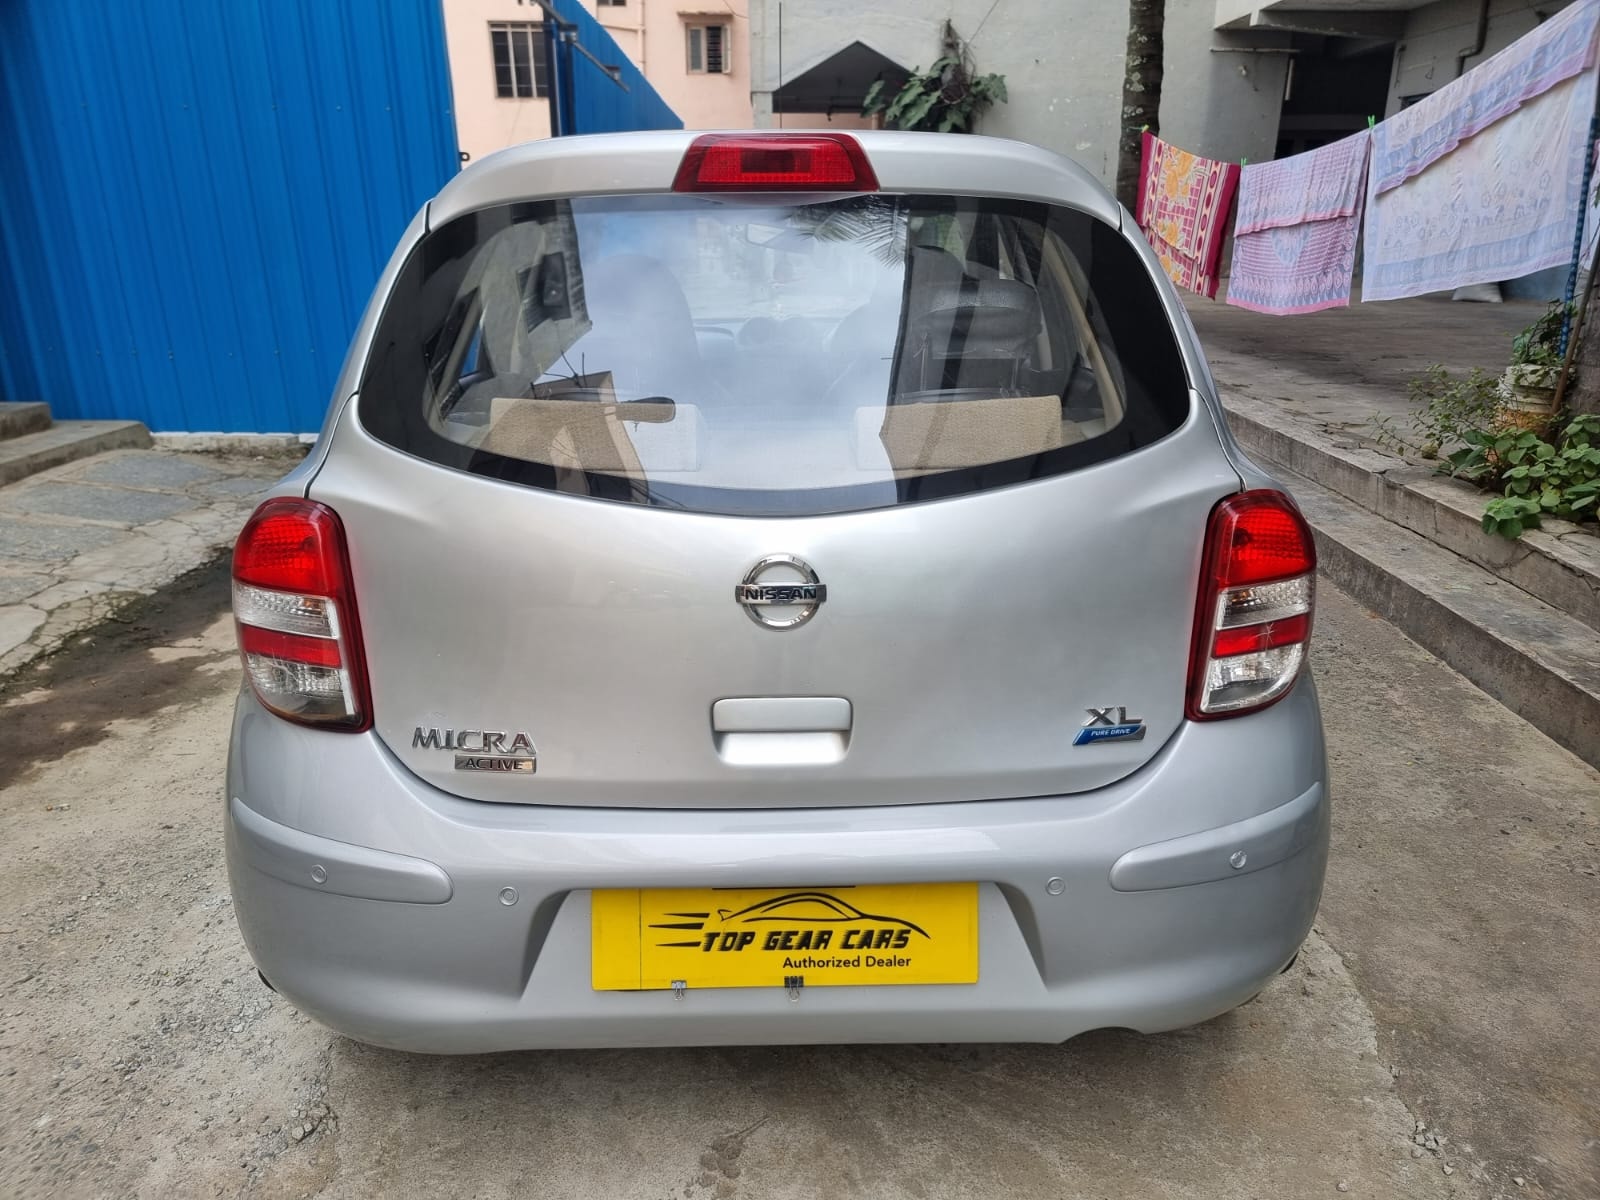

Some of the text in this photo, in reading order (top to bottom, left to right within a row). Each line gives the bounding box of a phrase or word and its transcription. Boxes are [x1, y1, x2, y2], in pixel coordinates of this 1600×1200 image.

[745, 588, 817, 600] NISSAN
[1081, 706, 1143, 727] XL
[1111, 728, 1131, 736] DRIVE
[411, 727, 537, 755] MICRA
[465, 757, 523, 770] ACTIVE
[702, 929, 911, 952] TOP GEAR CARS
[783, 955, 911, 969] Authorized Dealer
